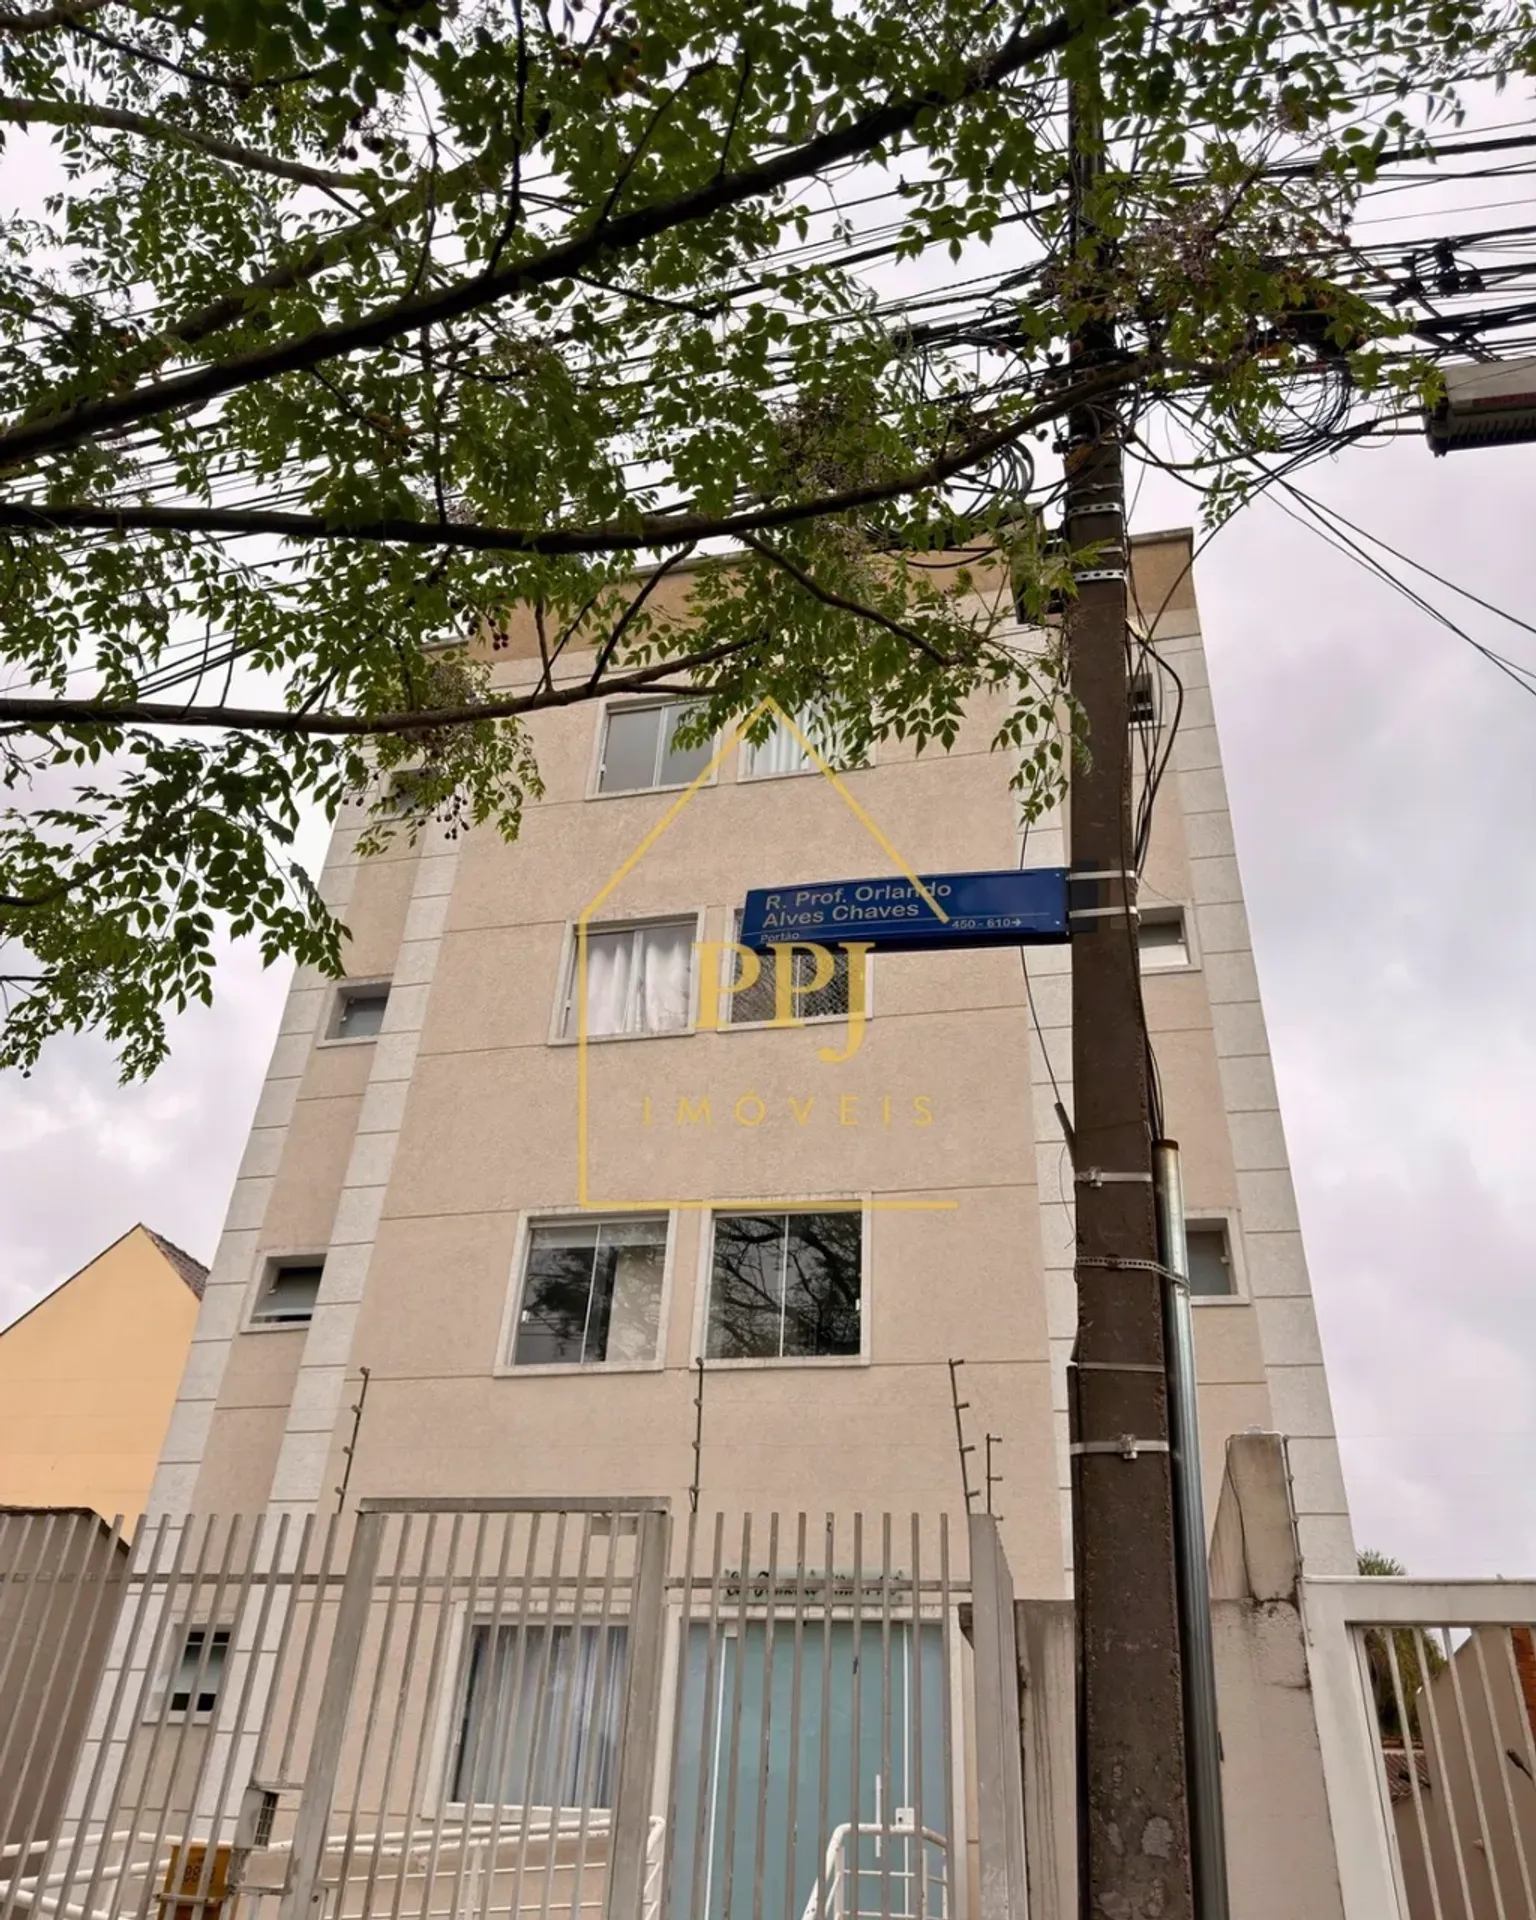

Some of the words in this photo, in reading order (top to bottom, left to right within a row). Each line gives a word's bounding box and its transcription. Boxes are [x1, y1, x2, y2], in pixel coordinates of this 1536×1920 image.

[765, 894, 787, 911] R.
[795, 887, 847, 907] Prof.
[762, 911, 824, 928] Alves
[832, 904, 919, 921] Chaves
[760, 931, 800, 944] Portão
